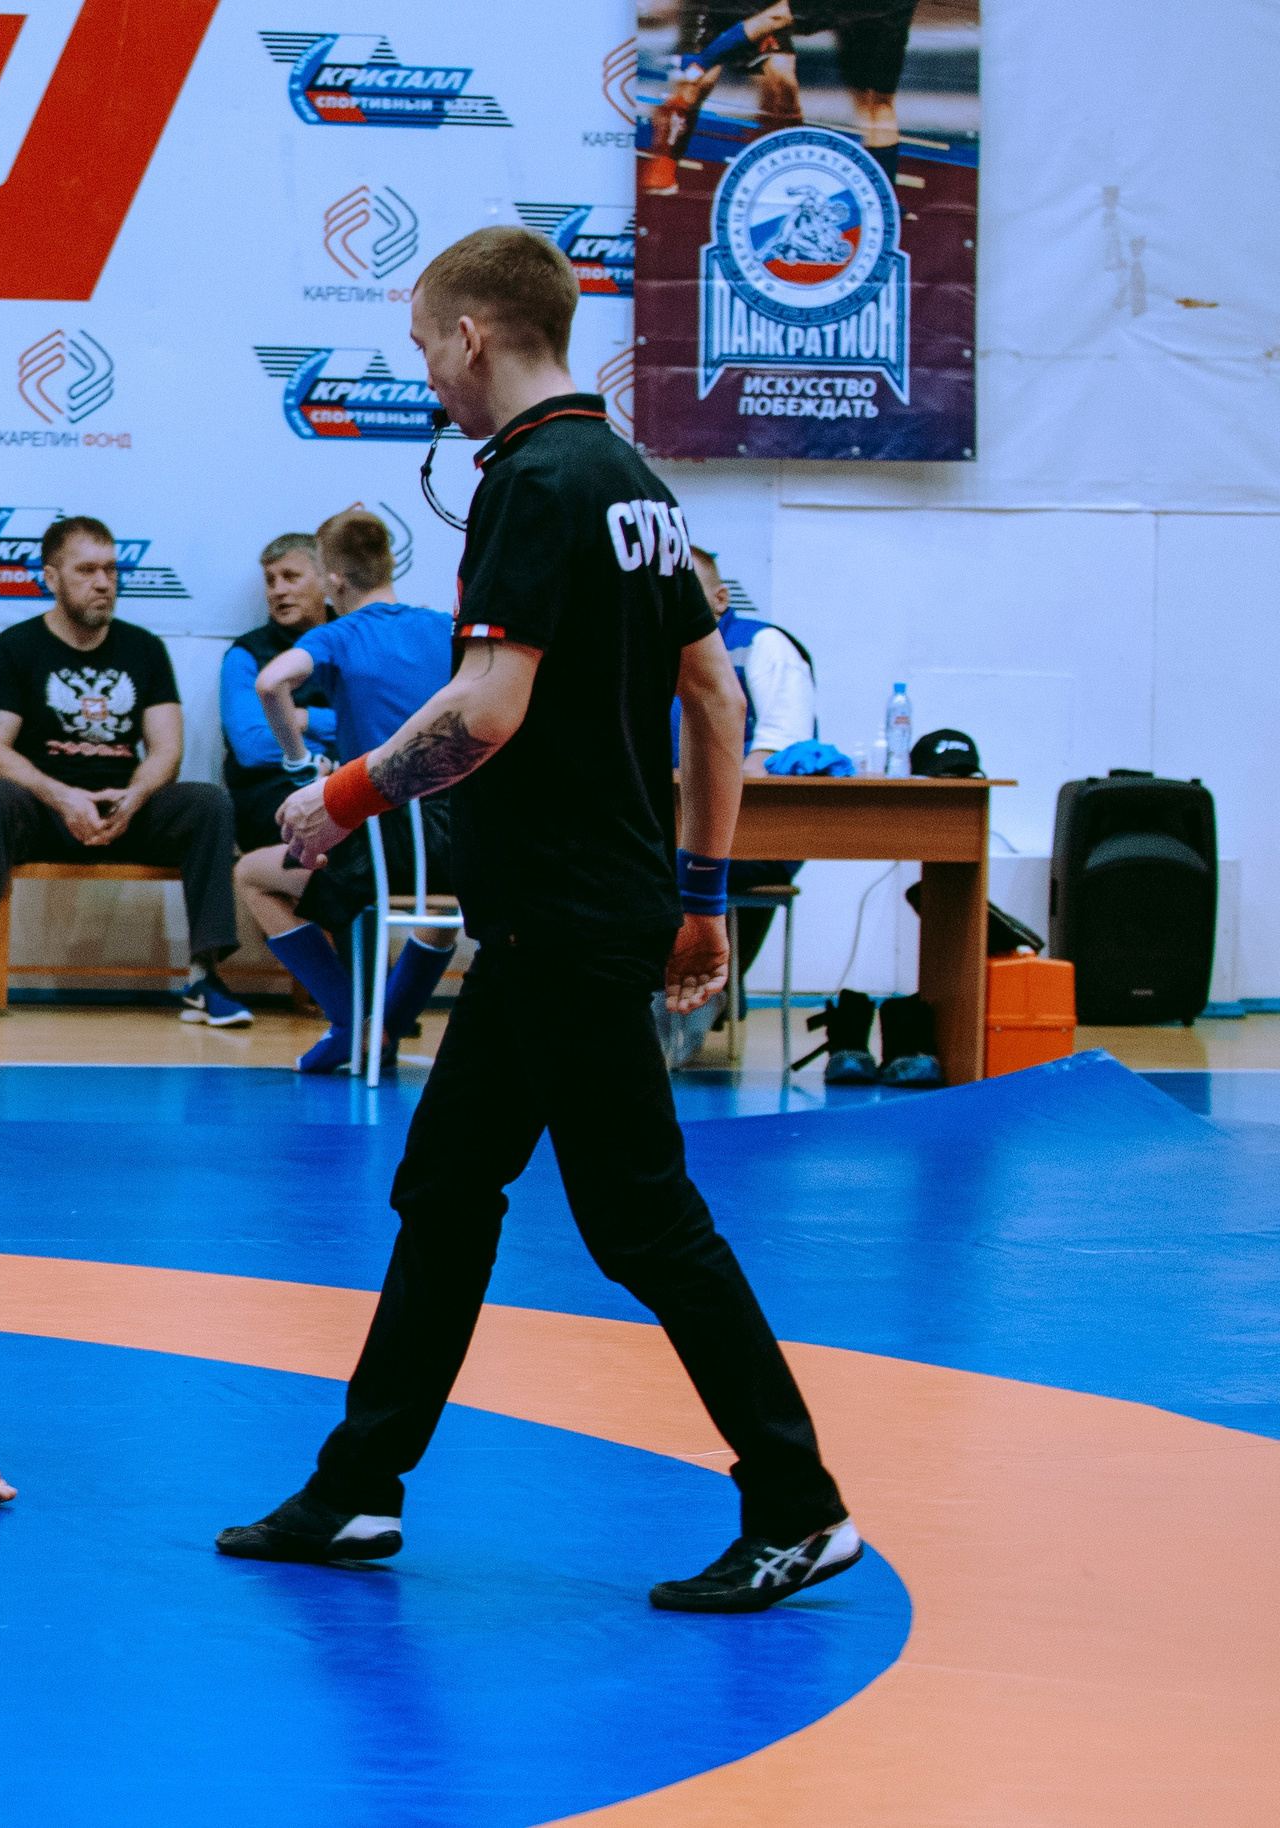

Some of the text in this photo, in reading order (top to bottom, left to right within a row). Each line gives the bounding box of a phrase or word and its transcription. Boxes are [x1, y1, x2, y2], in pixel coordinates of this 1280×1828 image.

[315, 66, 468, 90] КРИСТАЛЛ
[315, 94, 433, 112] СПОРТИВНЫЙ
[303, 285, 384, 303] КАРЕЛИН
[712, 257, 898, 365] ПАНКРАТИОН
[310, 381, 439, 403] КРИСТАЛ
[743, 375, 877, 398] ИСКУССТВО
[310, 409, 428, 425] СПОРТИВНЫЙ
[738, 398, 880, 420] ПОБЕЖДАТЬ
[83, 432, 132, 449] ФОНД
